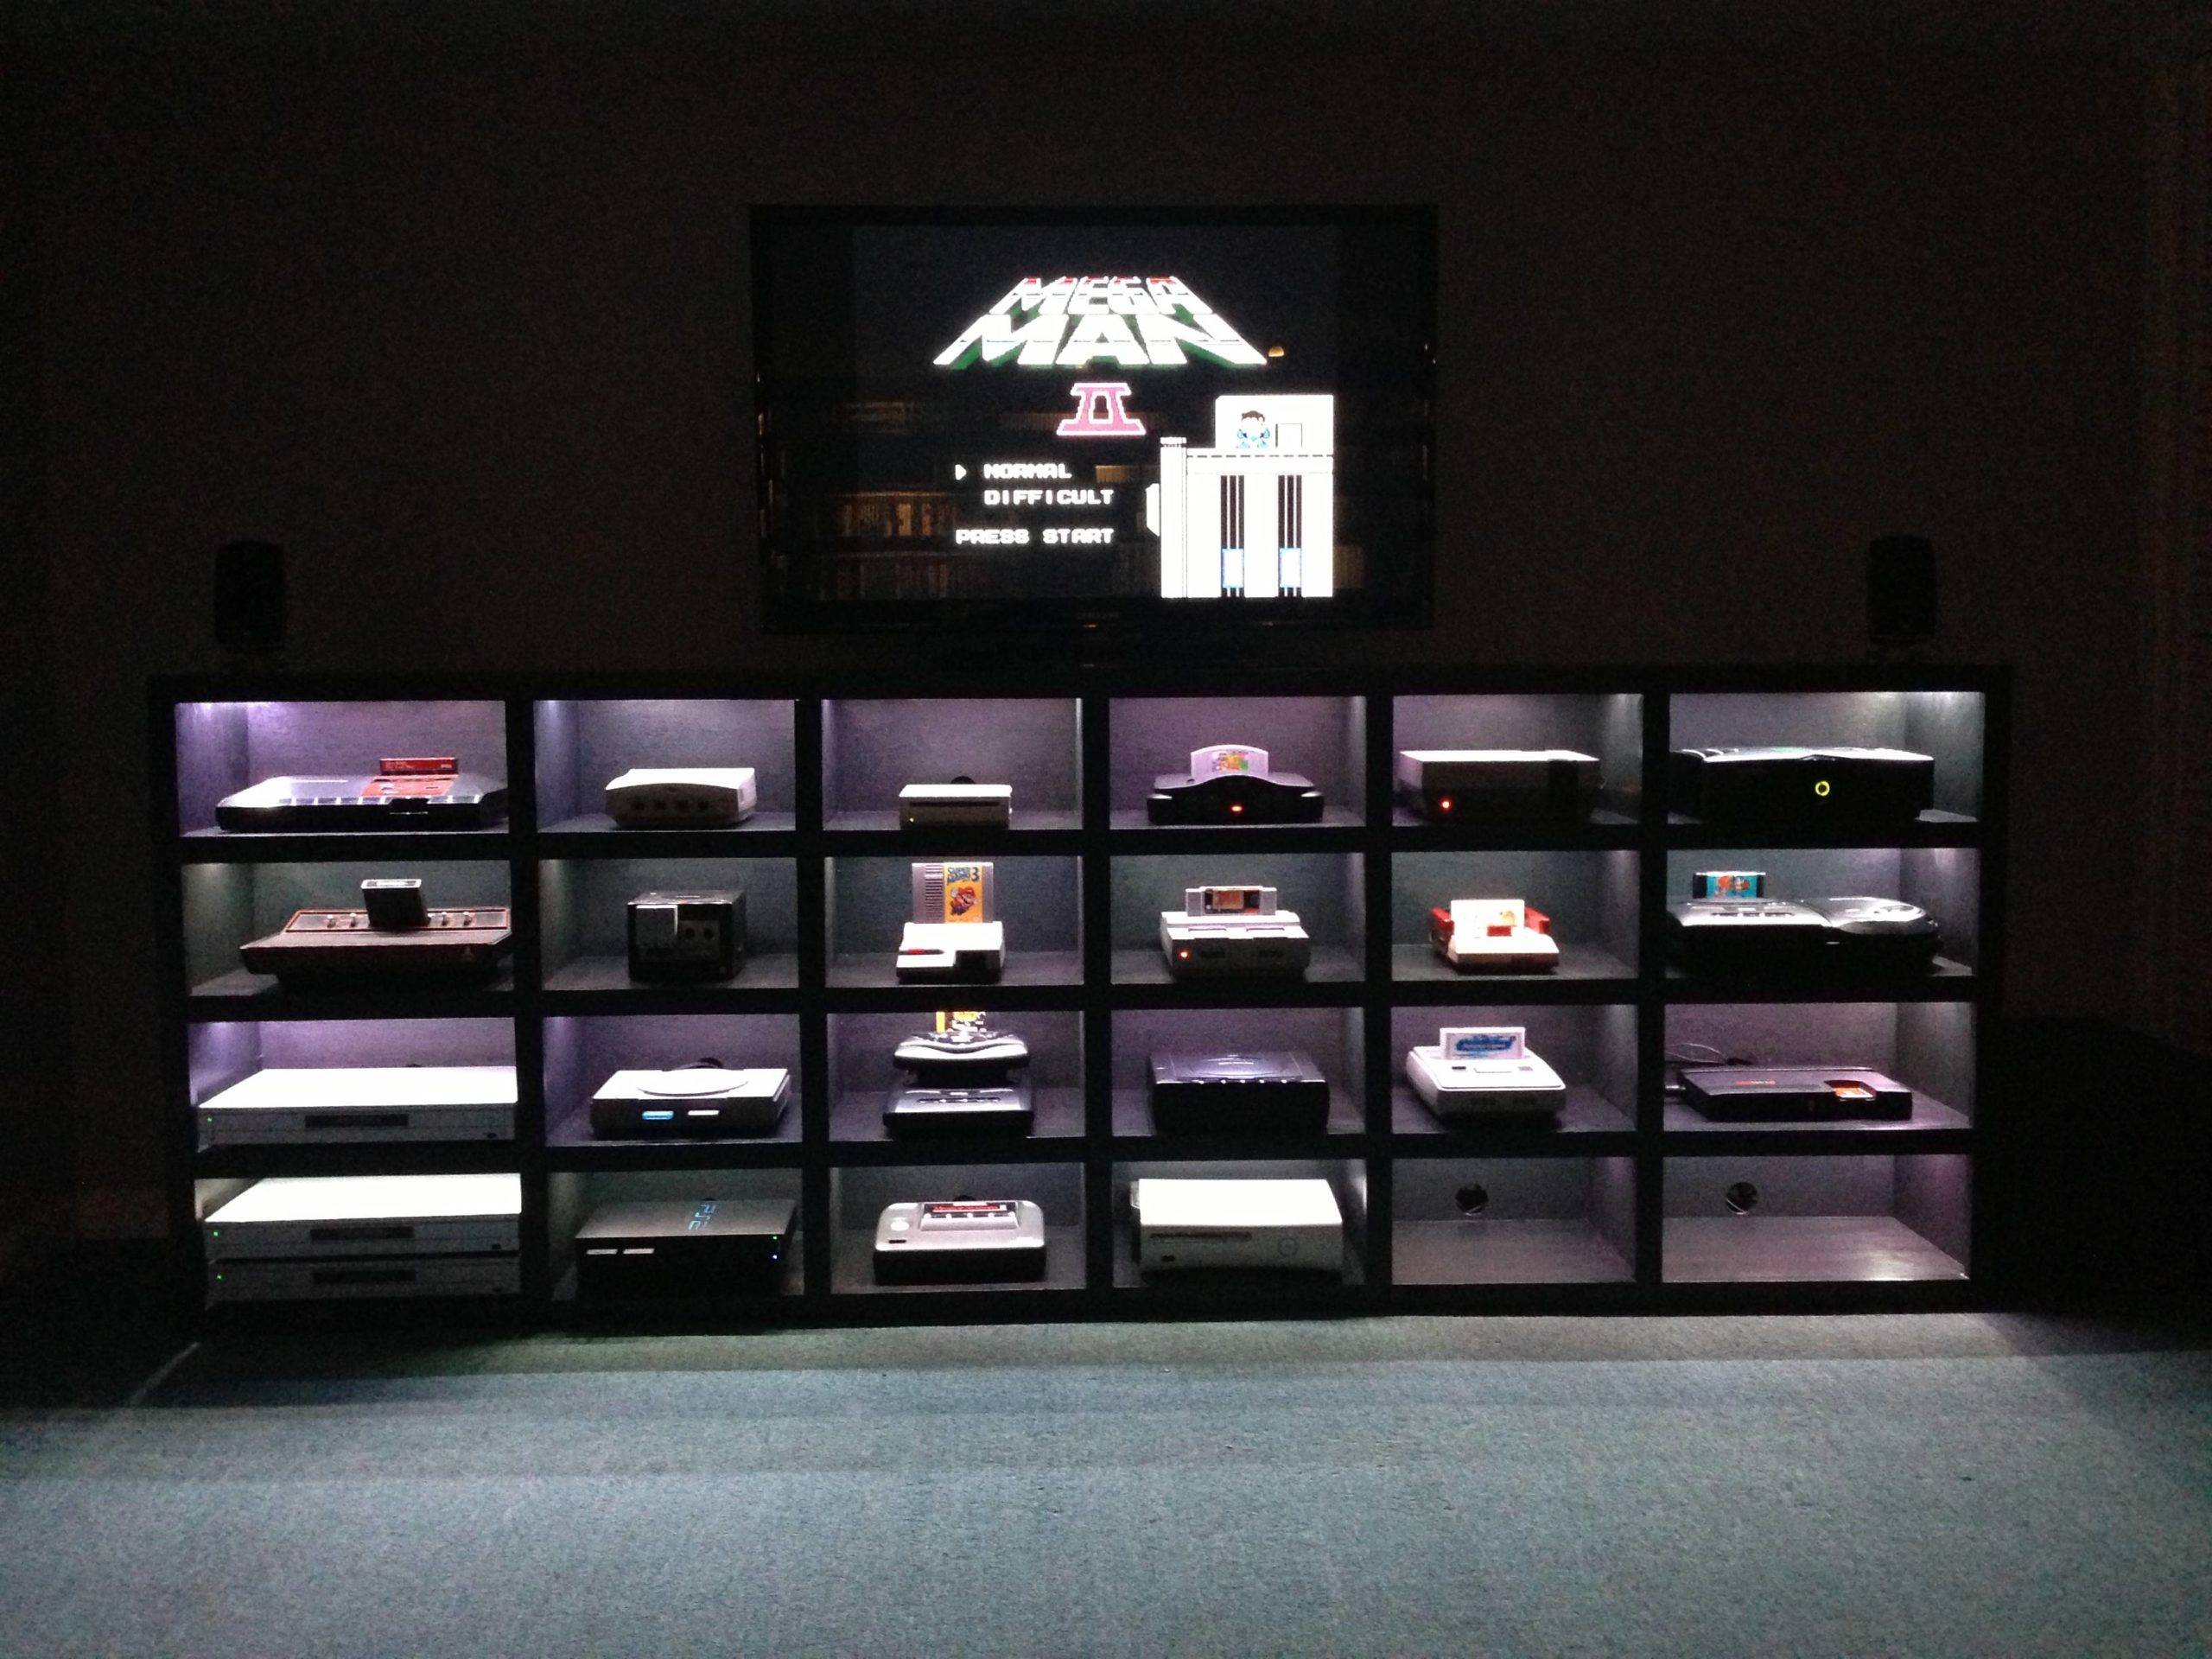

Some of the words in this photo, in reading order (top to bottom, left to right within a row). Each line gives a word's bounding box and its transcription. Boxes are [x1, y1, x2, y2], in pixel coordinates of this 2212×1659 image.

[988, 276, 1214, 315] MEGA
[932, 313, 1268, 367] MAN
[1056, 382, 1147, 435] II
[982, 463, 1072, 480] NORMAL
[983, 489, 1114, 505] DIFFICULT
[956, 528, 1030, 545] PRESS
[1042, 528, 1115, 544] START
[971, 867, 980, 881] 3
